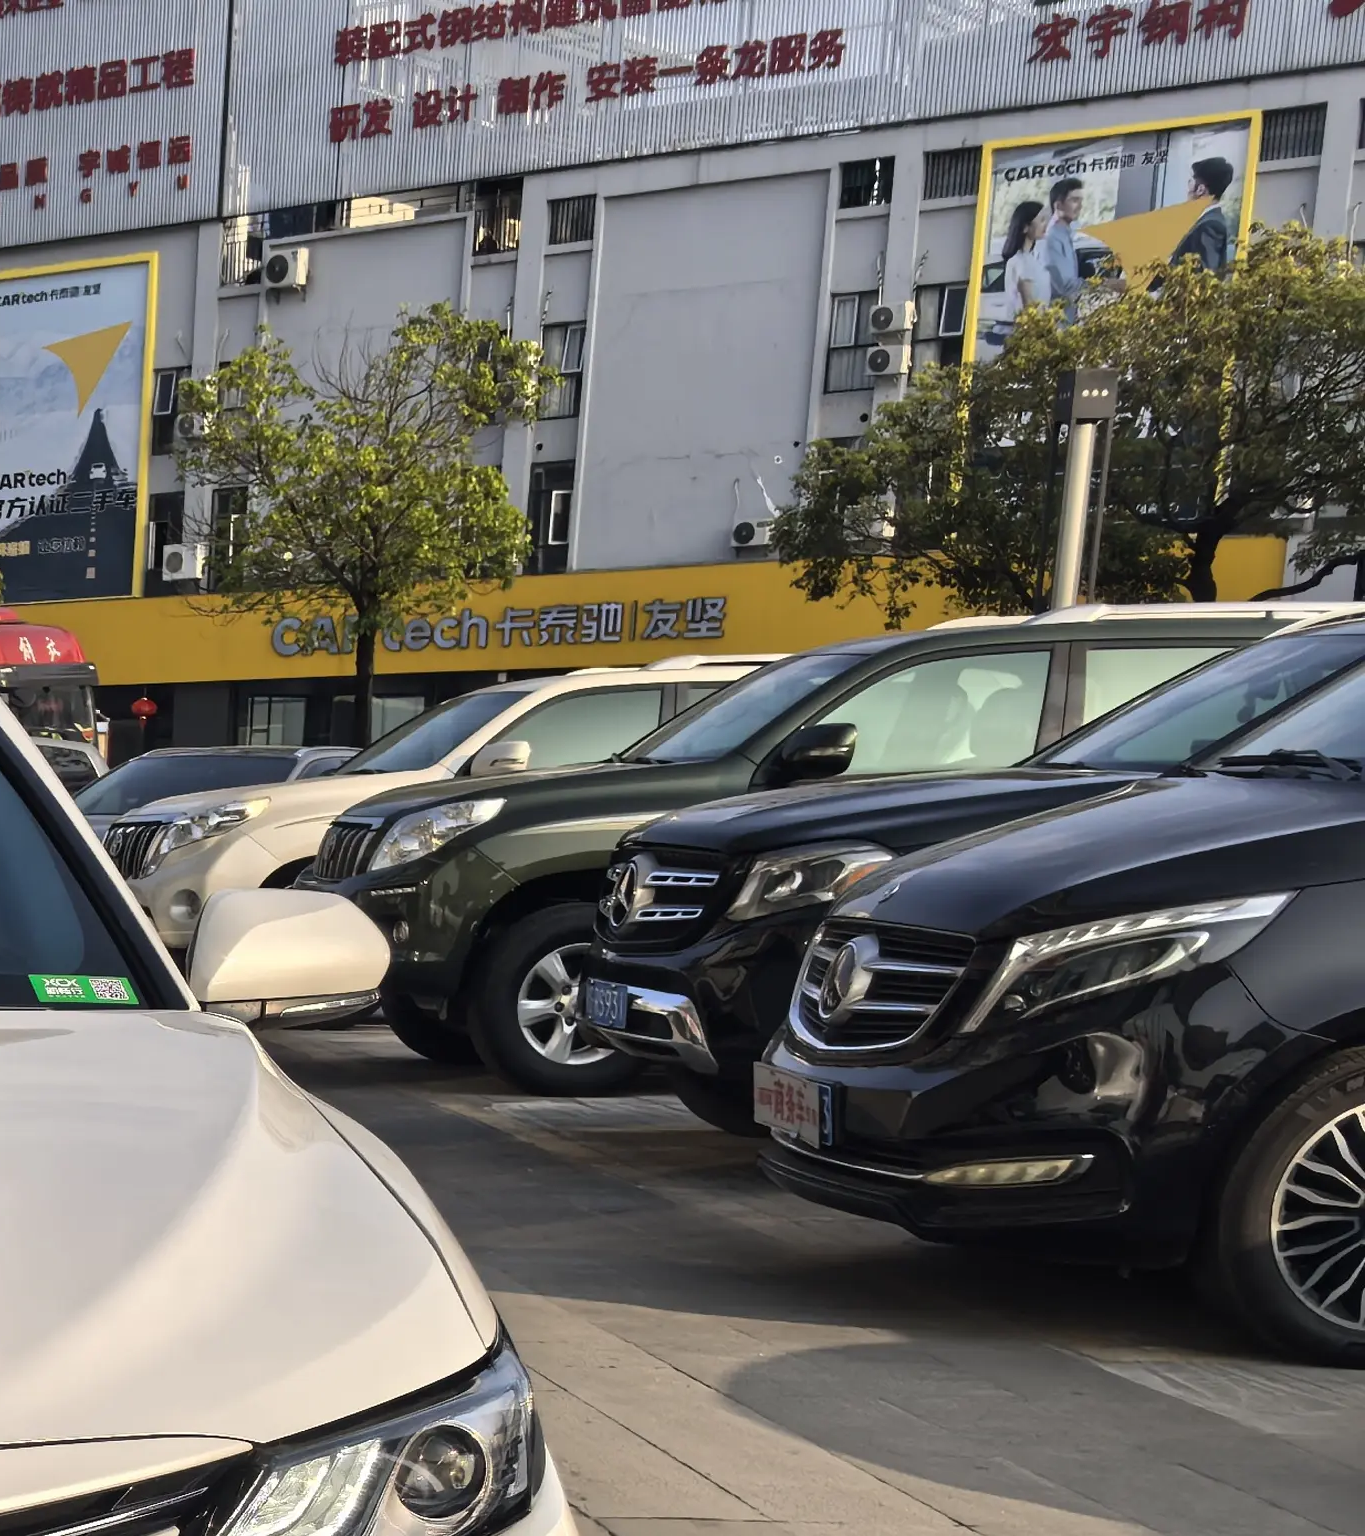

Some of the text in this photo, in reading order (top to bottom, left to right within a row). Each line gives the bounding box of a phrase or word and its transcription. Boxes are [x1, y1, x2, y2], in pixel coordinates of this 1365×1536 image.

[329, 28, 846, 143] 研发 设计 制作 安装一条龙服务
[494, 602, 624, 648] 卡泰驰
[641, 597, 728, 641] 友坚
